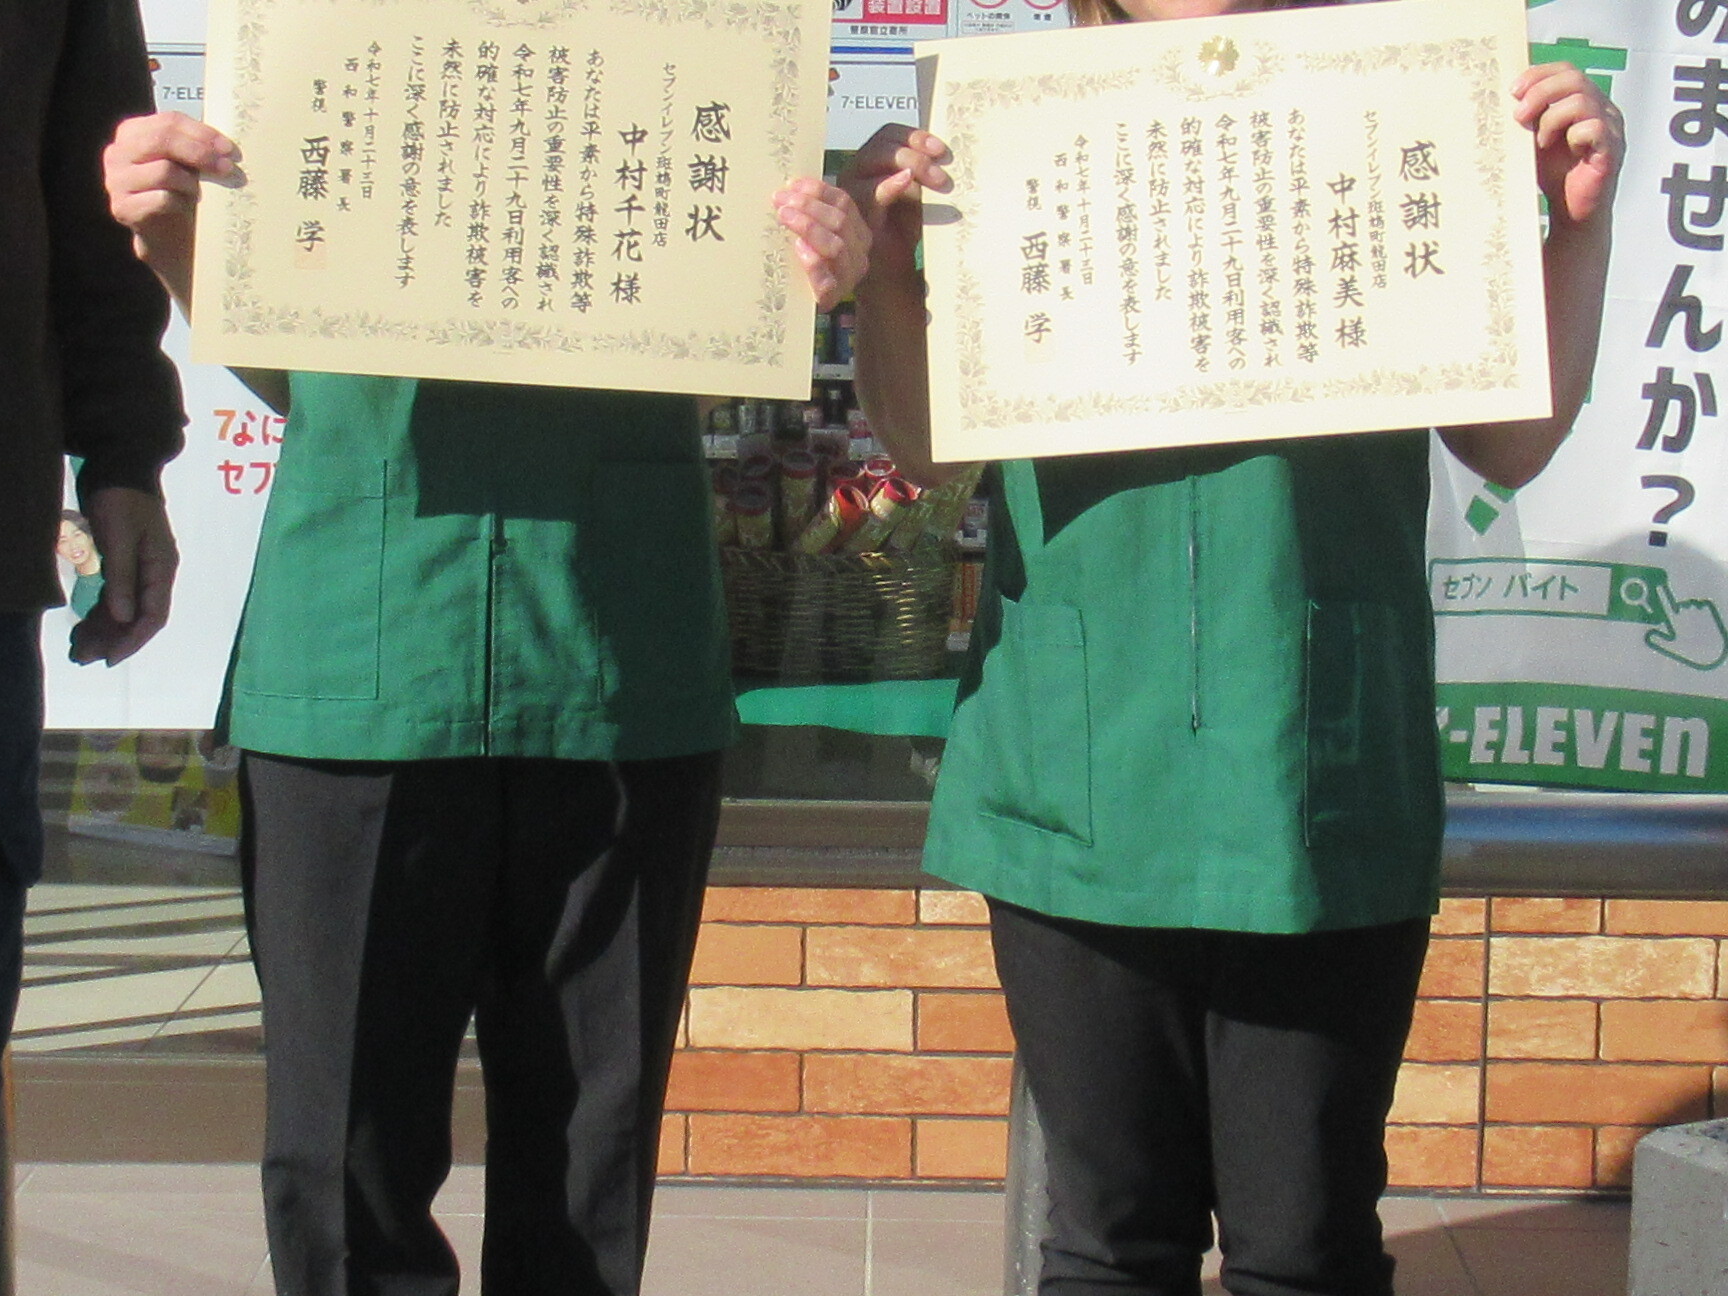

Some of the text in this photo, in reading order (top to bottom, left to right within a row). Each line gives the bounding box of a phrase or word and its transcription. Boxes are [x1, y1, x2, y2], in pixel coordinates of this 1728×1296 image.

[359, 40, 383, 200] 令和七年十月二十三日
[393, 34, 426, 290] ここに深く感謝の意を表します
[434, 37, 465, 229] 未然に防止されました
[464, 39, 501, 308] 的確な対応により詐欺被害を
[500, 42, 537, 310] 令和七年九月二十九日利用客への
[570, 48, 605, 314] あなたは平素から特殊詐欺等
[684, 101, 731, 243] 感謝状
[1074, 134, 1093, 286] 令和七年十月二十三日
[1145, 120, 1172, 301] 未然に防止されました
[1214, 113, 1248, 371] 令和七年九月二十九日利用客への
[1286, 108, 1320, 364] あなたは平素から特殊詐欺等
[1398, 140, 1446, 279] 感謝状
[1113, 122, 1142, 366] ここに深く感謝の意を表します
[1180, 117, 1212, 373] 的確な対応により詐欺被害を
[1504, 570, 1579, 602] バイト
